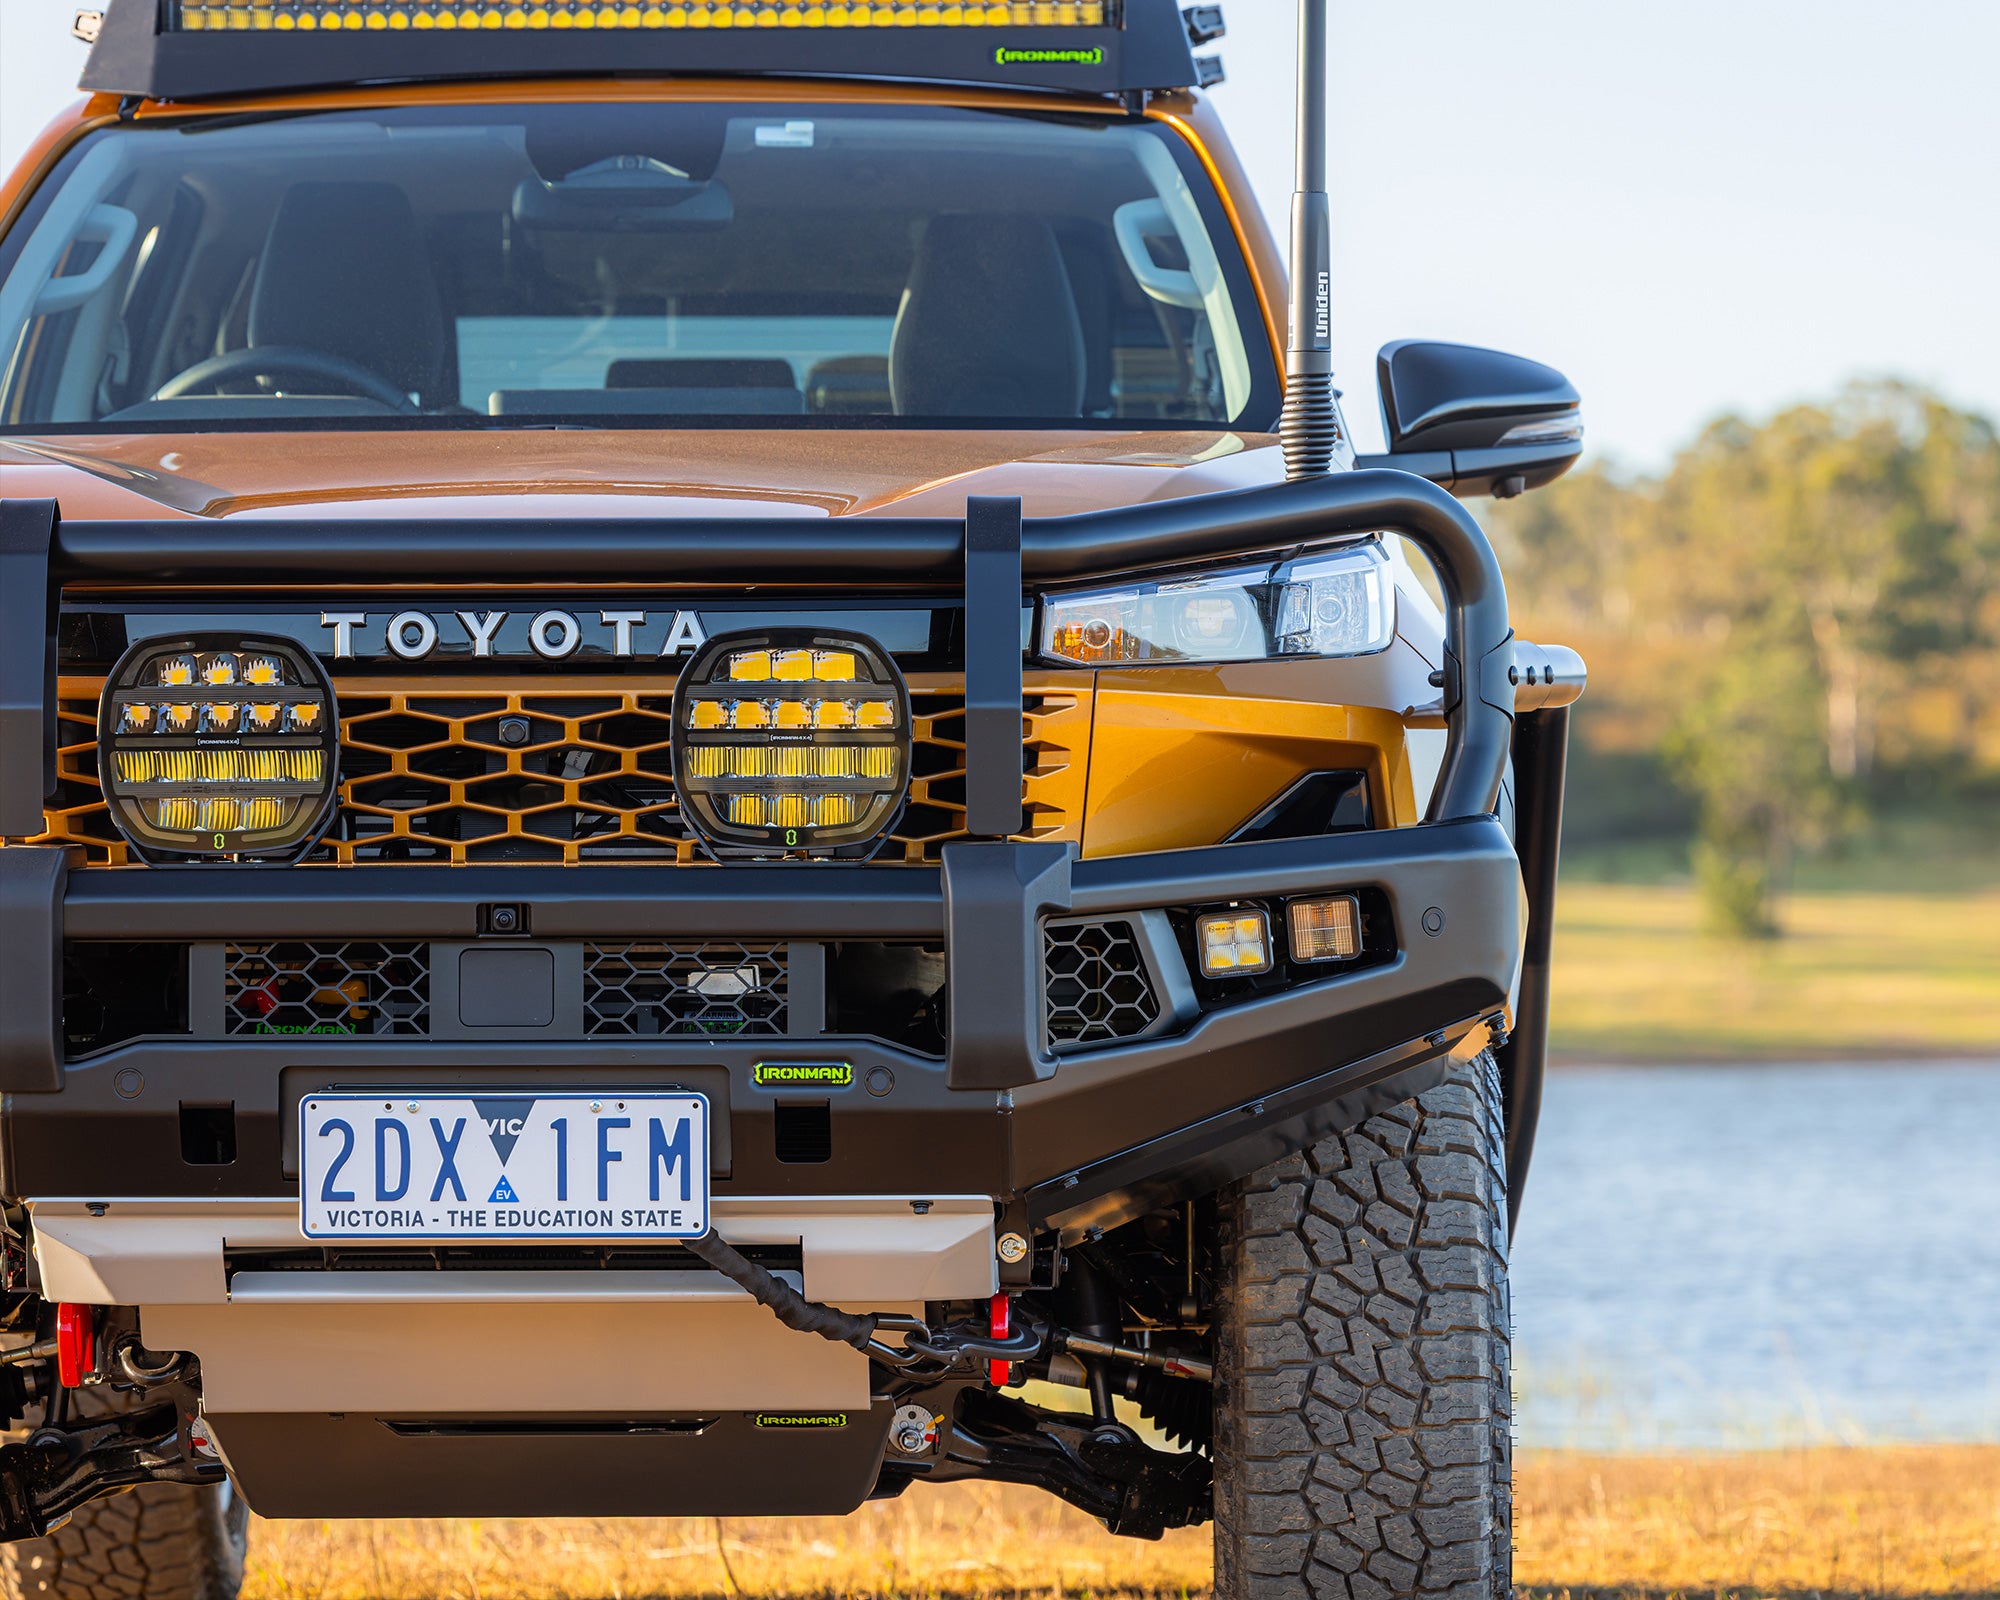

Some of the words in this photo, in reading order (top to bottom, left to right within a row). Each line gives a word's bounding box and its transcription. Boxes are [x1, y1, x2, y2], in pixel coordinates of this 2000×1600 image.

[1004, 50, 1093, 61] IRONMAN
[1316, 271, 1328, 337] Uniden
[320, 609, 706, 660] TOYOTA
[763, 1067, 844, 1079] IRONMAN
[481, 1118, 523, 1135] VIC
[318, 1117, 467, 1202] 2DX
[550, 1117, 690, 1201] 1FM
[495, 1190, 511, 1199] EV
[327, 1210, 425, 1227] VICTORIA
[447, 1210, 487, 1227] THE
[495, 1209, 613, 1227] EDUCATION
[621, 1209, 682, 1227] STATE
